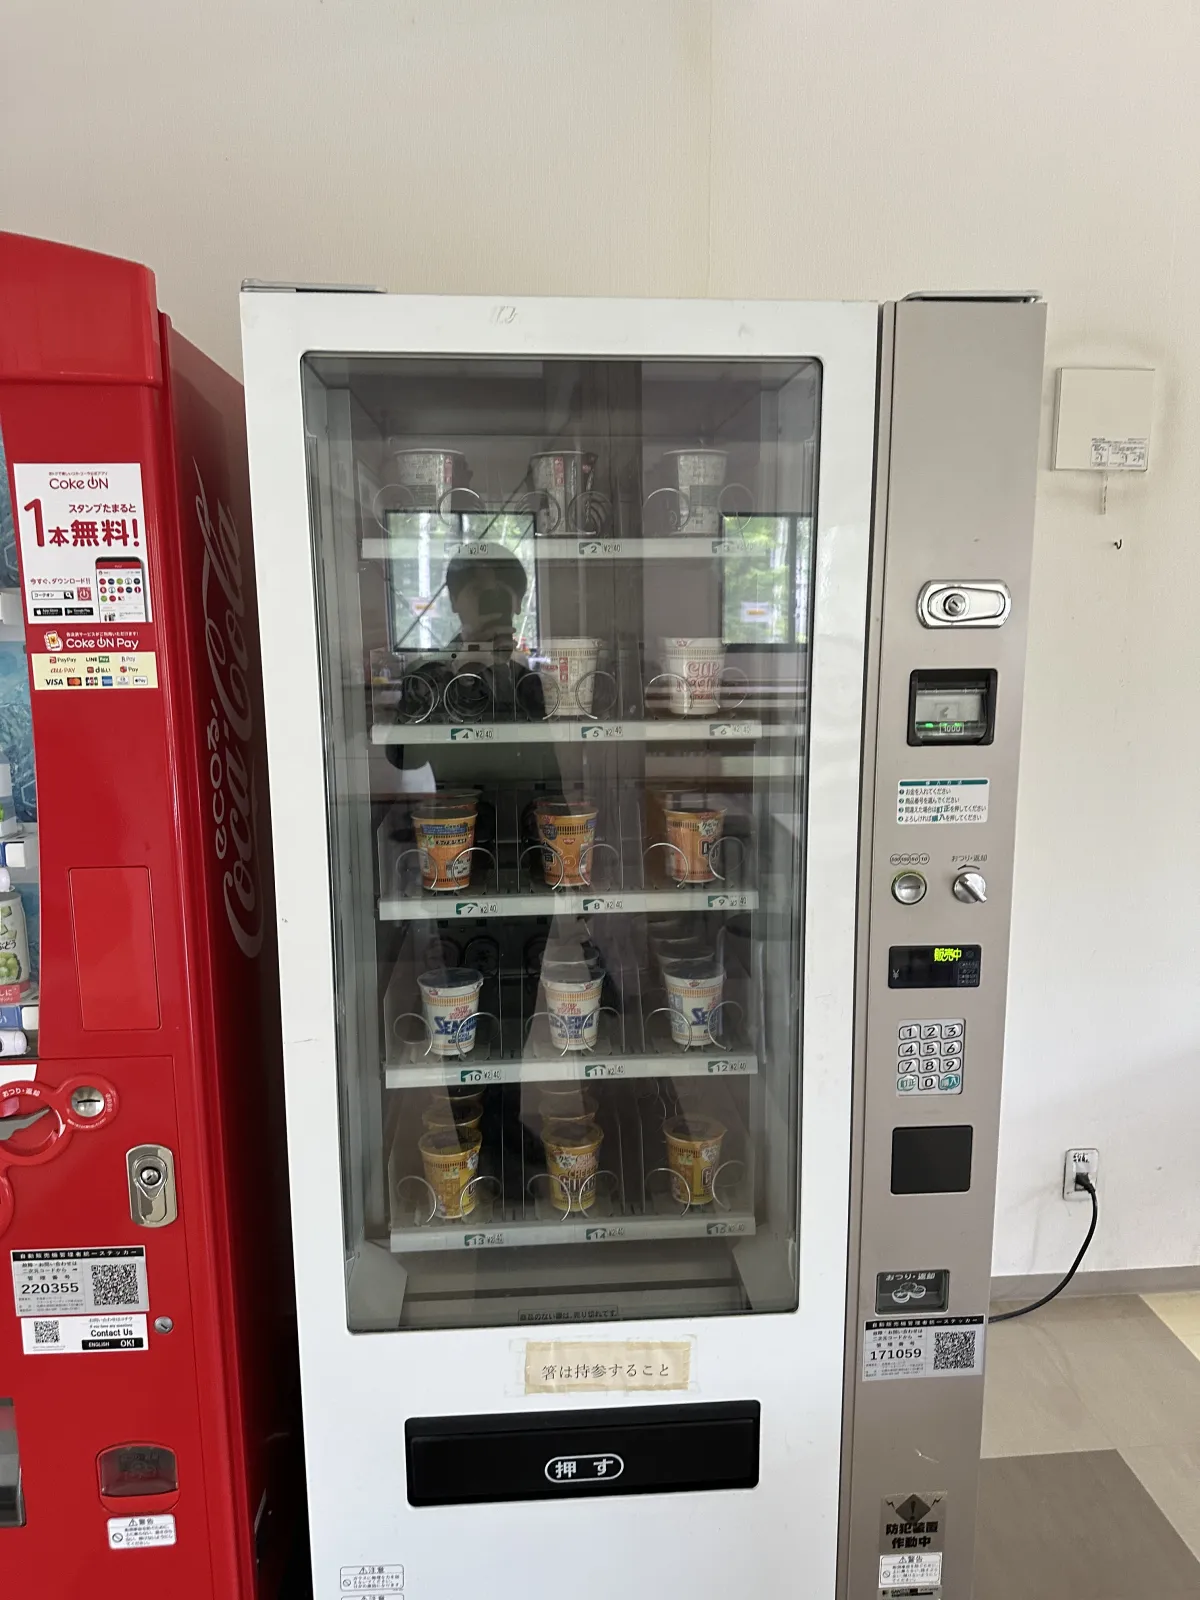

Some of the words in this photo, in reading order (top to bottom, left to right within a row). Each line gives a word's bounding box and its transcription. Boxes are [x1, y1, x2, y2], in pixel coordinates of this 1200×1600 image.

[49, 478, 85, 490] Coke
[87, 476, 108, 490] ON
[69, 504, 136, 514] スタンプたまると
[590, 545, 598, 554] 2
[66, 638, 95, 648] Coke
[97, 637, 114, 648] ON
[116, 638, 139, 650] Pay
[192, 456, 264, 960] Coca-Cola
[475, 730, 492, 738] ¥240
[592, 729, 600, 738] 5
[720, 727, 727, 735] 6
[934, 948, 962, 962] 販売中
[907, 1028, 912, 1037] 1
[928, 1028, 936, 1036] 2
[948, 1026, 956, 1036] 3
[906, 1045, 914, 1054] 4
[926, 1044, 934, 1053] 5
[947, 1044, 955, 1054] 6
[905, 1062, 912, 1071] 7
[926, 1061, 934, 1070] 8
[946, 1061, 954, 1070] 9
[470, 1074, 481, 1082] 10
[924, 1078, 933, 1088] 0
[22, 1282, 79, 1294] 220355
[91, 1330, 120, 1338] Contact
[120, 1340, 134, 1348] OK!
[870, 1348, 922, 1361] 171059
[542, 1364, 670, 1380] 箸は持参すること
[555, 1458, 614, 1478] 押す
[886, 1521, 938, 1535] 防犯装置
[892, 1536, 932, 1549] 作動中
